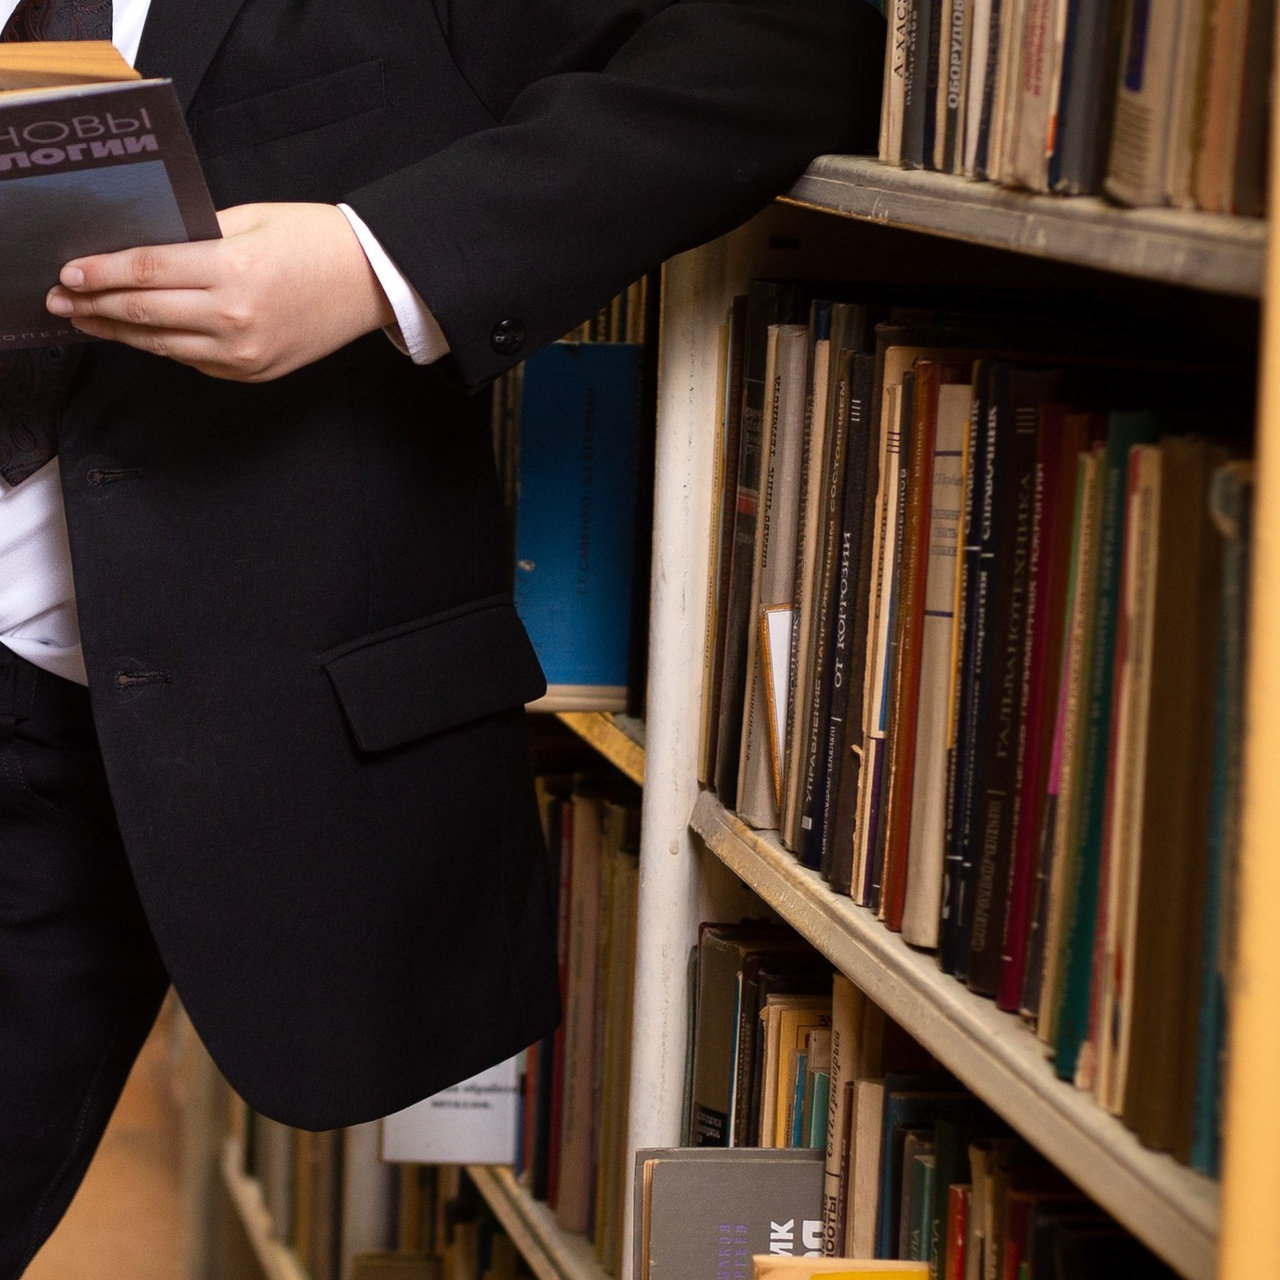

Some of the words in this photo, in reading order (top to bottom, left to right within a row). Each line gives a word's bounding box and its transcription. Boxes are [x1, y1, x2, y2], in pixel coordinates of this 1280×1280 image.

[981, 405, 998, 541] СПРАВОЧНИК
[805, 678, 822, 803] УПРАВЛЕНИЕ
[815, 520, 836, 672] НАПРЯЖЕННЫМ
[829, 380, 846, 513] СОСТОЯНИЕМ
[836, 530, 852, 650] КОРРОЗИИ
[833, 657, 844, 689] ОТ
